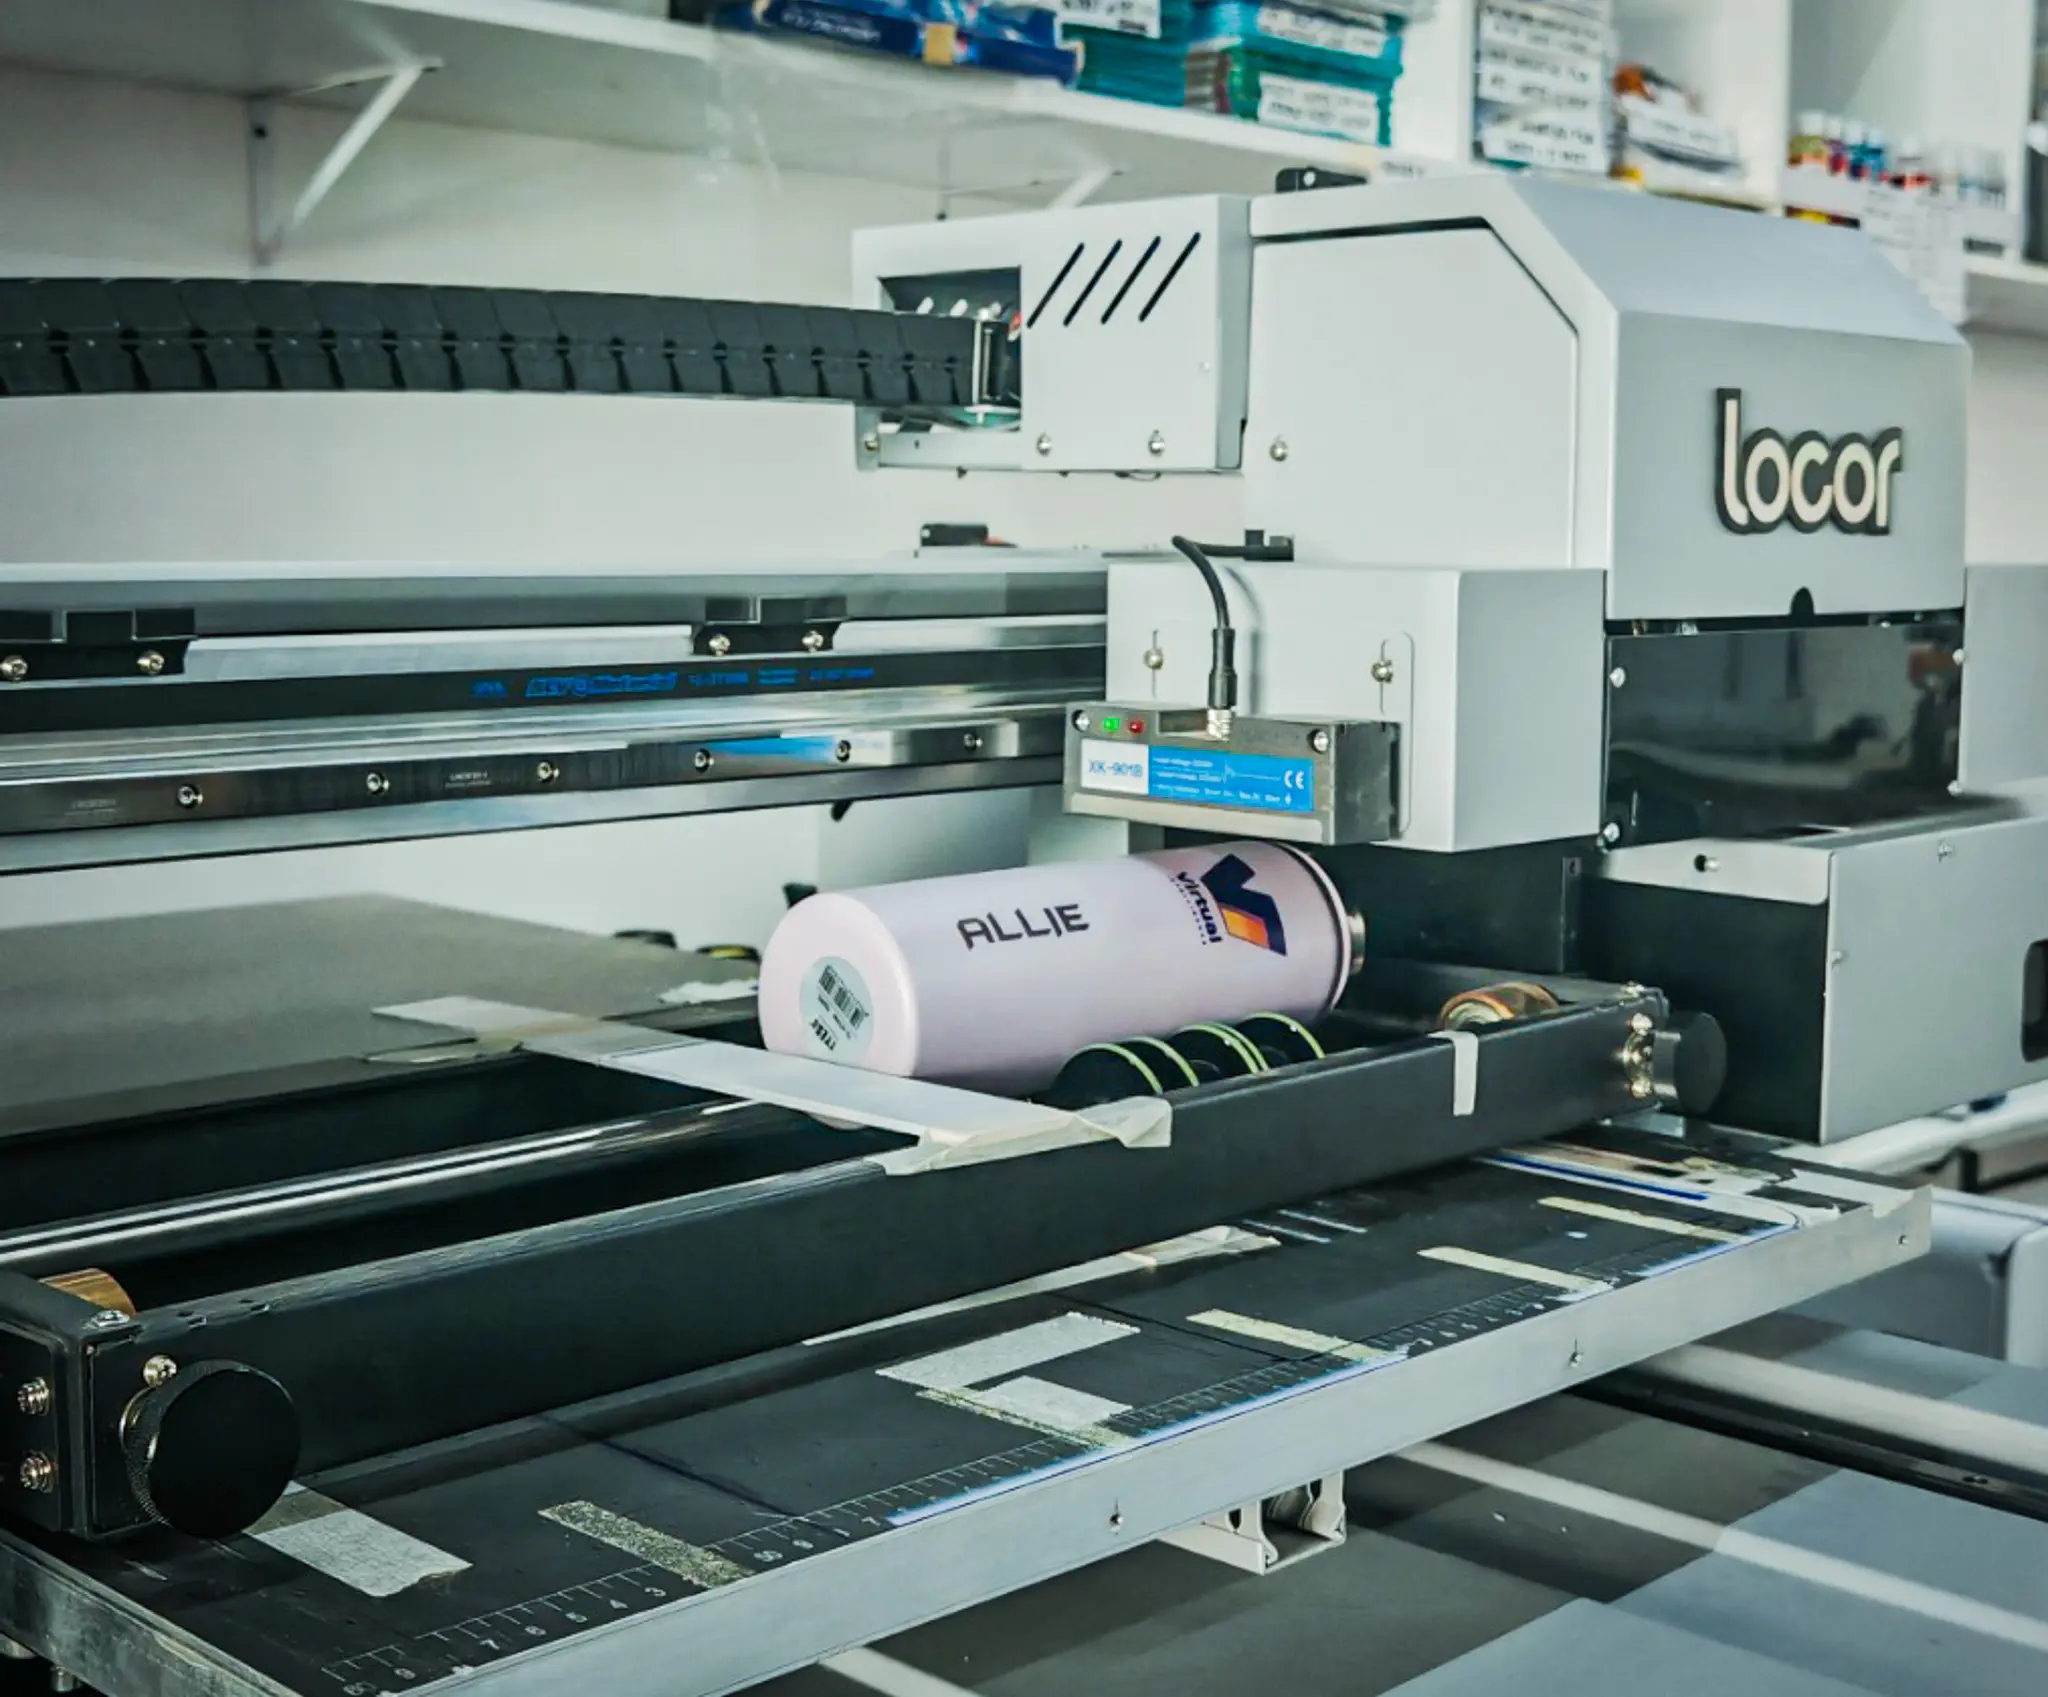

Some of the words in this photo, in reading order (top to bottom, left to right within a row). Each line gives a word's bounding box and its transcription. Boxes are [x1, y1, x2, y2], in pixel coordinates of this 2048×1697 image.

[1714, 387, 1903, 536] locor
[957, 903, 1090, 951] ALLIE
[1176, 871, 1223, 942] Virtual
